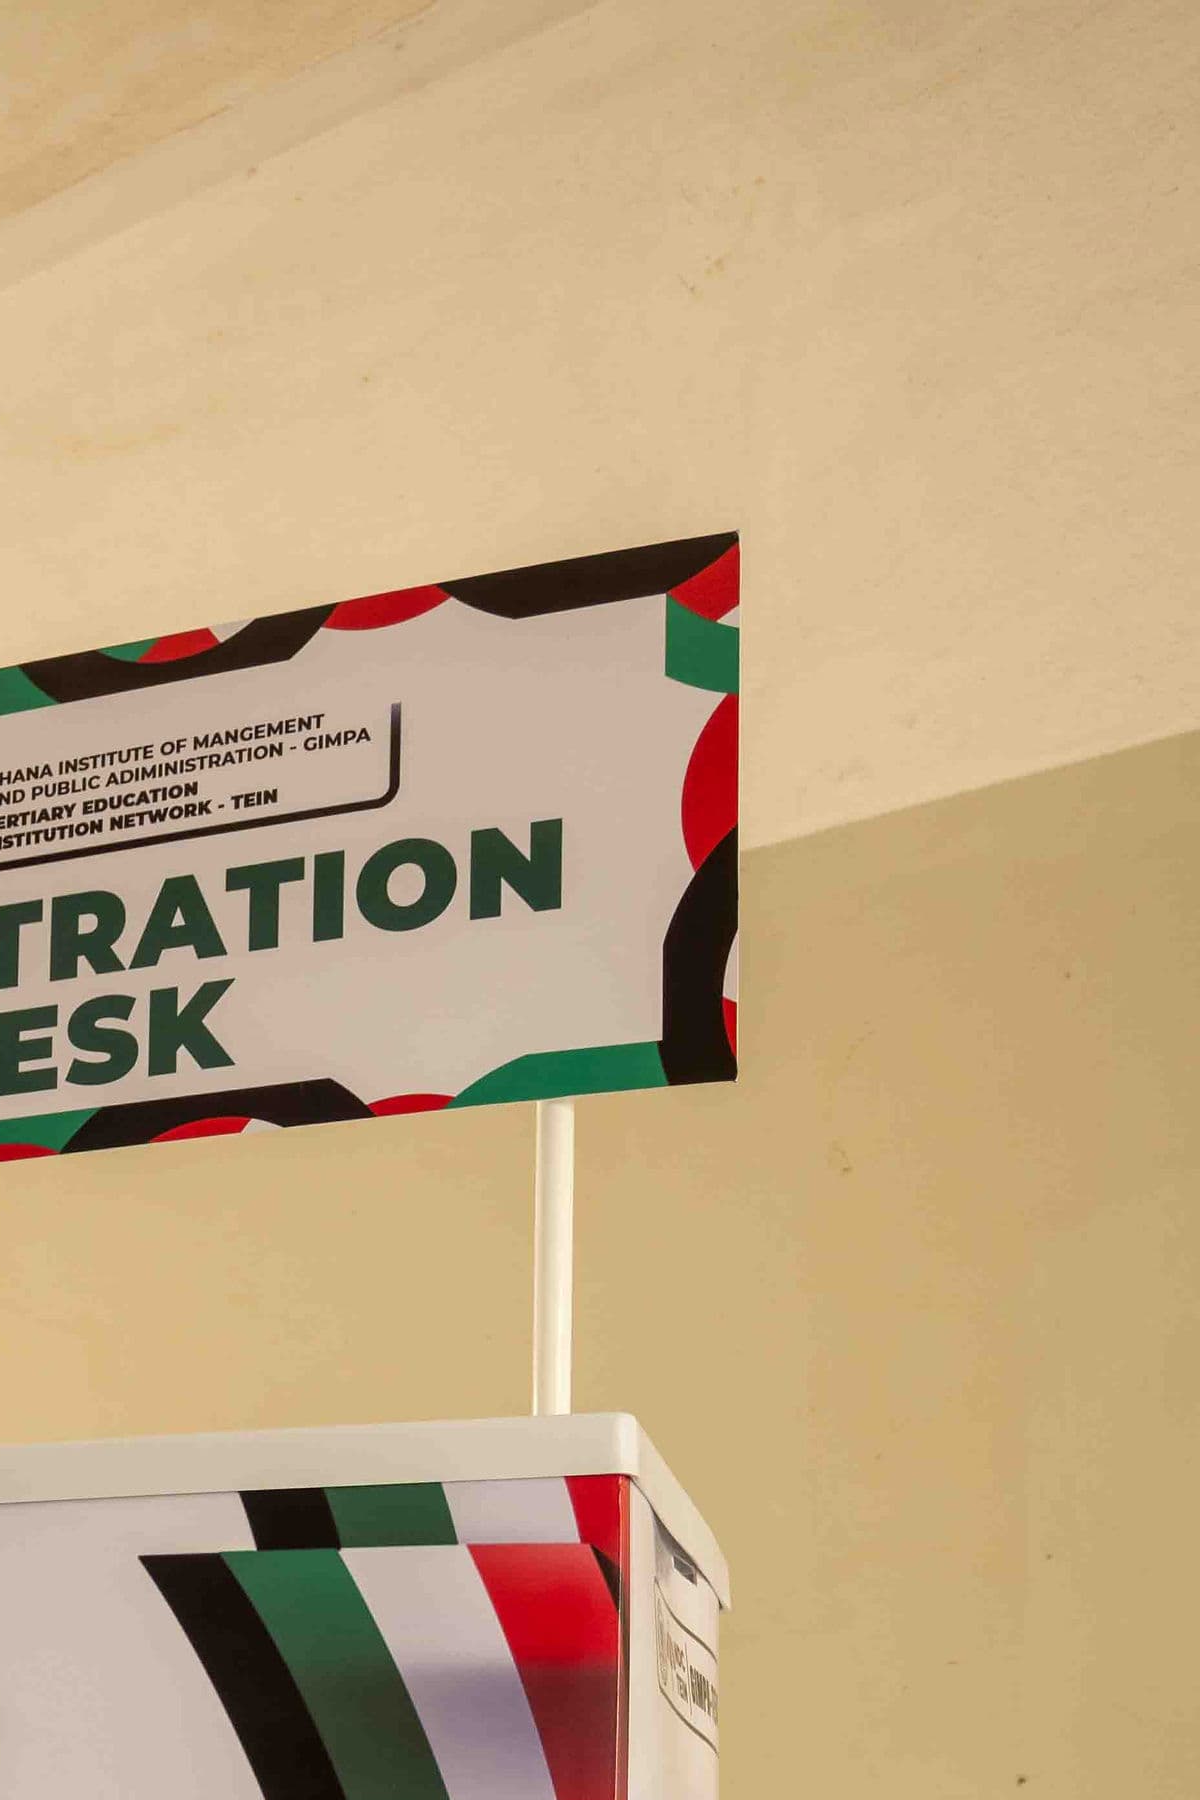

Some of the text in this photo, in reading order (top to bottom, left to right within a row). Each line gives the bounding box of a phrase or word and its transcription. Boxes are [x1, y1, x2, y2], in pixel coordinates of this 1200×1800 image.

[32, 776, 100, 800] PUBLIC
[106, 742, 283, 787] ADIMINISTRATION
[303, 727, 371, 751] GIMPA
[59, 744, 154, 775] INSTITUTE
[160, 738, 187, 756] OF
[193, 714, 325, 750] MANGEMENT
[83, 781, 198, 815] EDUCATION
[110, 800, 212, 831] NETWORK
[231, 789, 278, 809] TEIN
